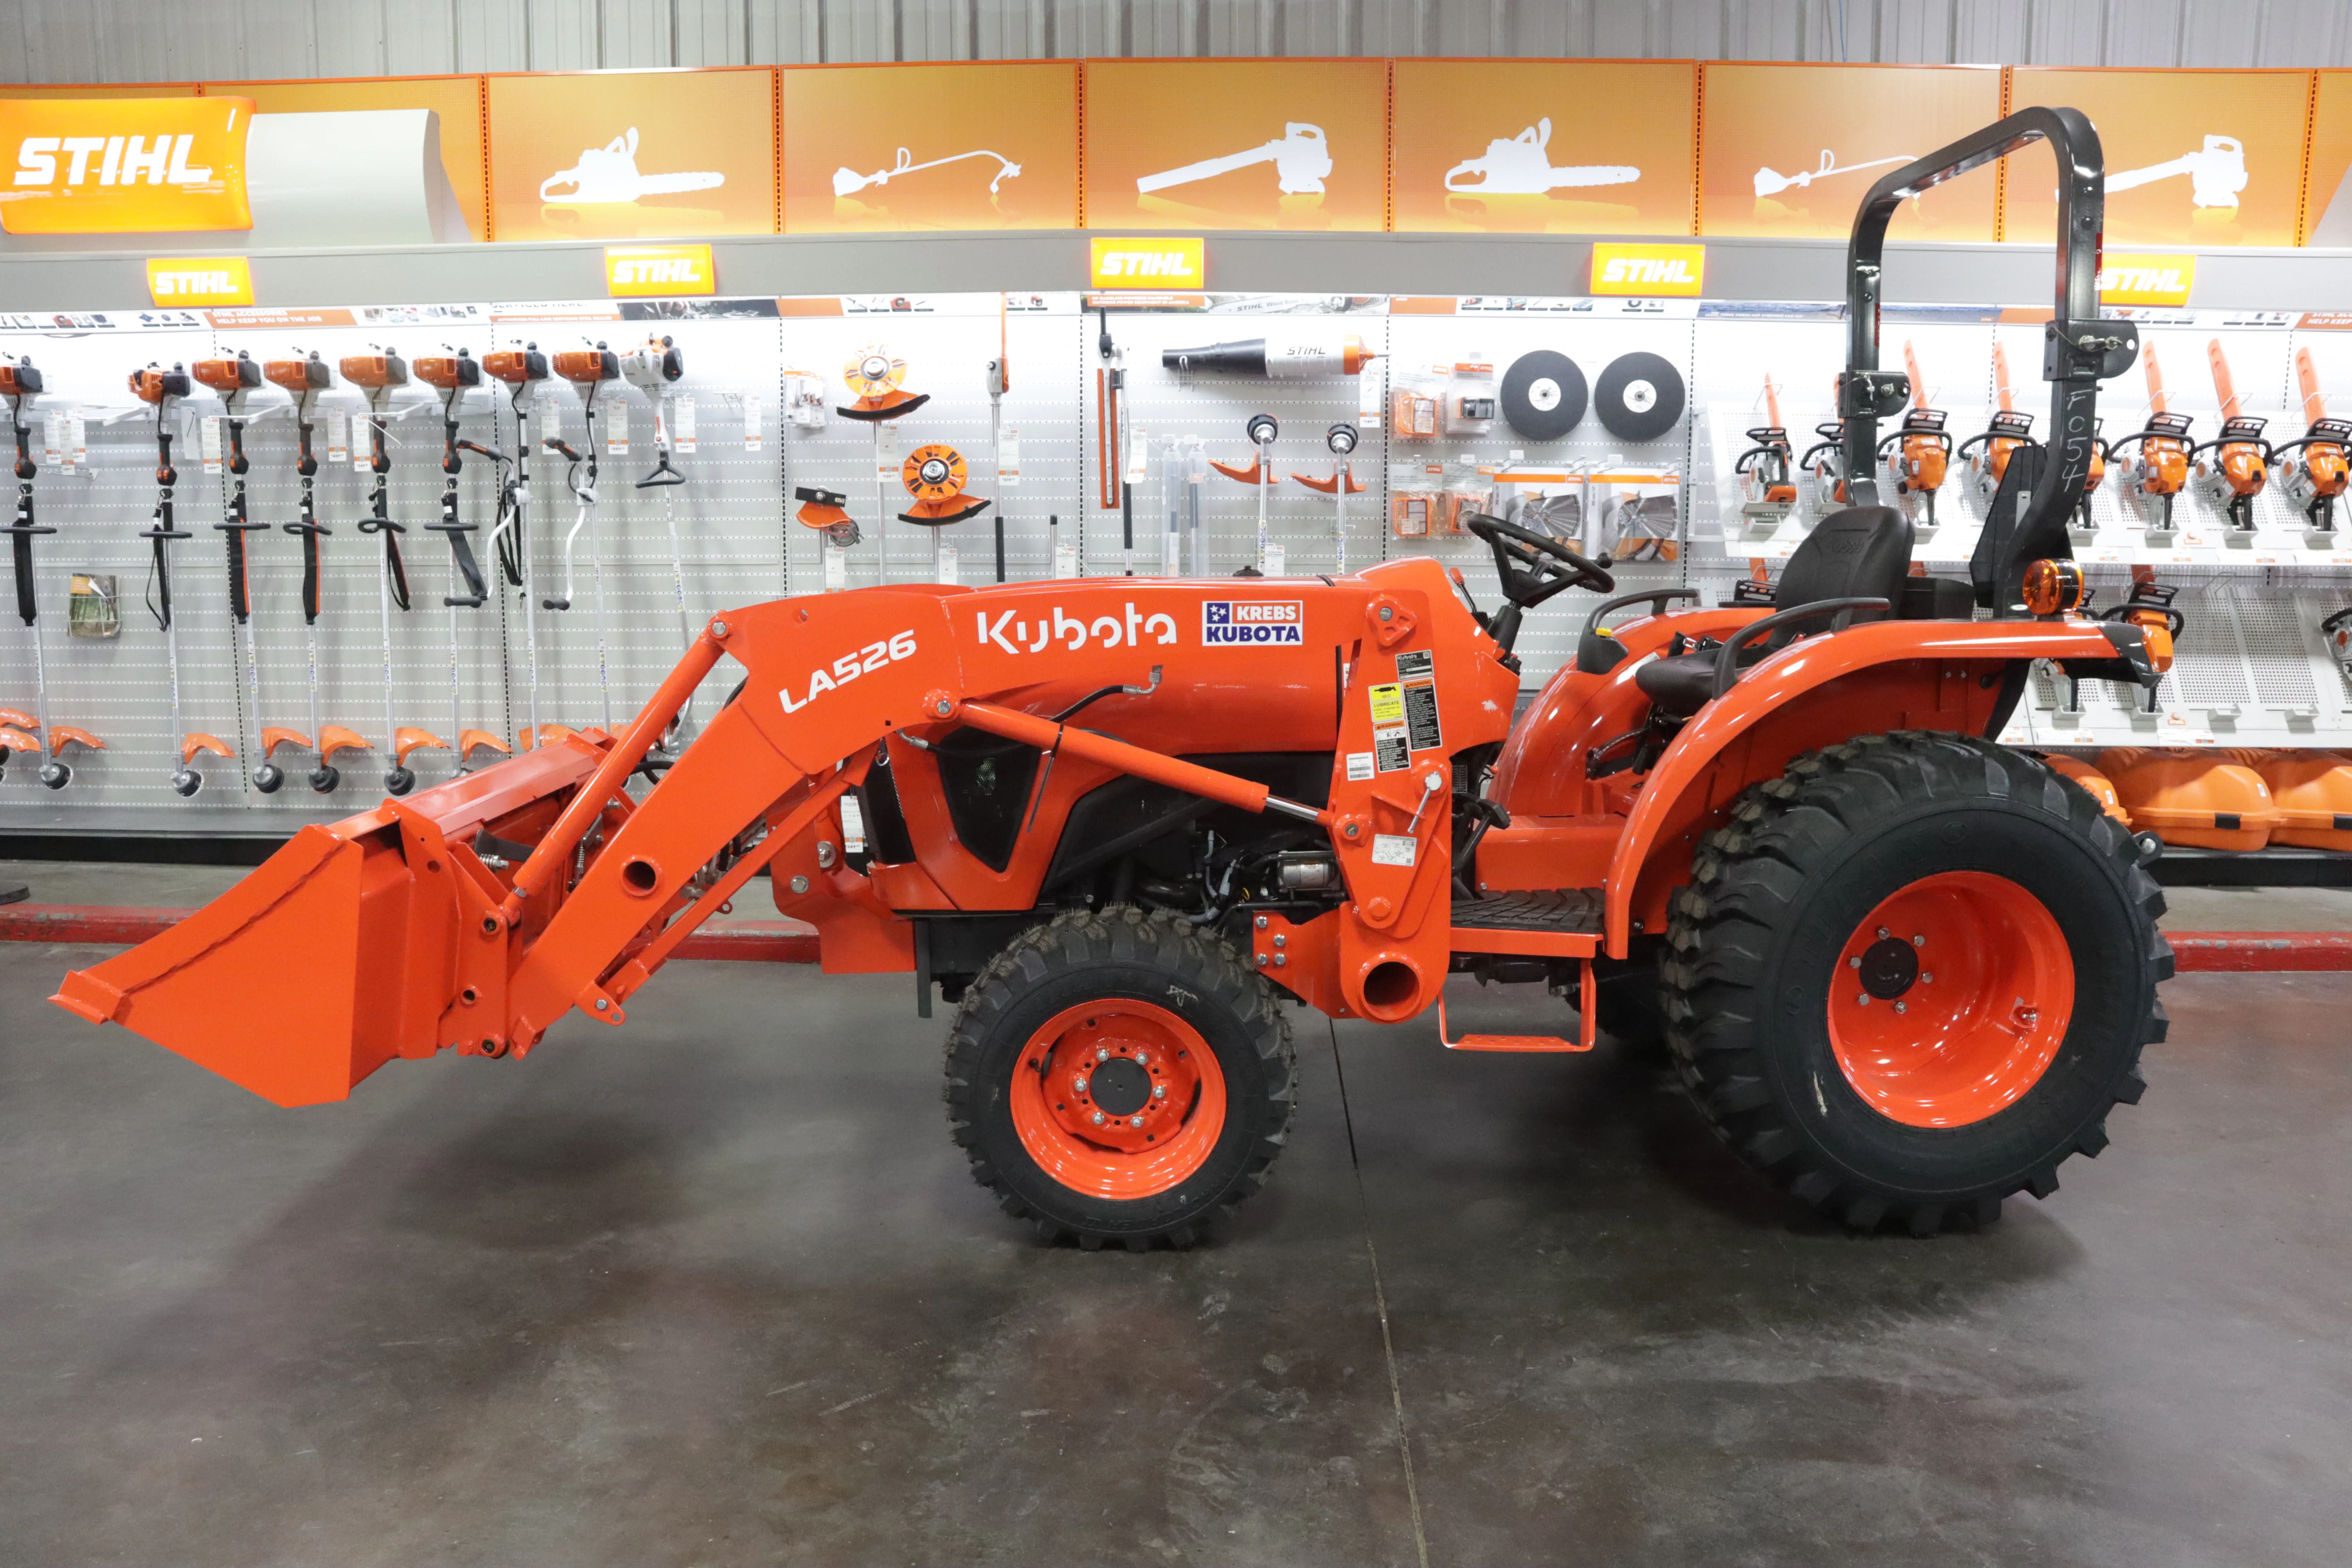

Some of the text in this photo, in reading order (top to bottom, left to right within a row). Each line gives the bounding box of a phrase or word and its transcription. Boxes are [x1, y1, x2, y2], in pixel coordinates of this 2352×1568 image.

[14, 134, 212, 186] STIHL
[613, 259, 701, 283] STIHL
[1100, 252, 1192, 275] STIHL
[1602, 259, 1694, 283] STIHL
[155, 271, 238, 294] STIHL
[2100, 268, 2186, 292] STIHL
[1237, 303, 1263, 312] STIHL
[1287, 347, 1325, 355] STIHL
[2062, 388, 2093, 492] F054
[1236, 605, 1296, 621] KREBS
[976, 603, 1177, 654] Kubota
[1206, 626, 1301, 642] KUBOTA
[779, 629, 917, 713] LA526
